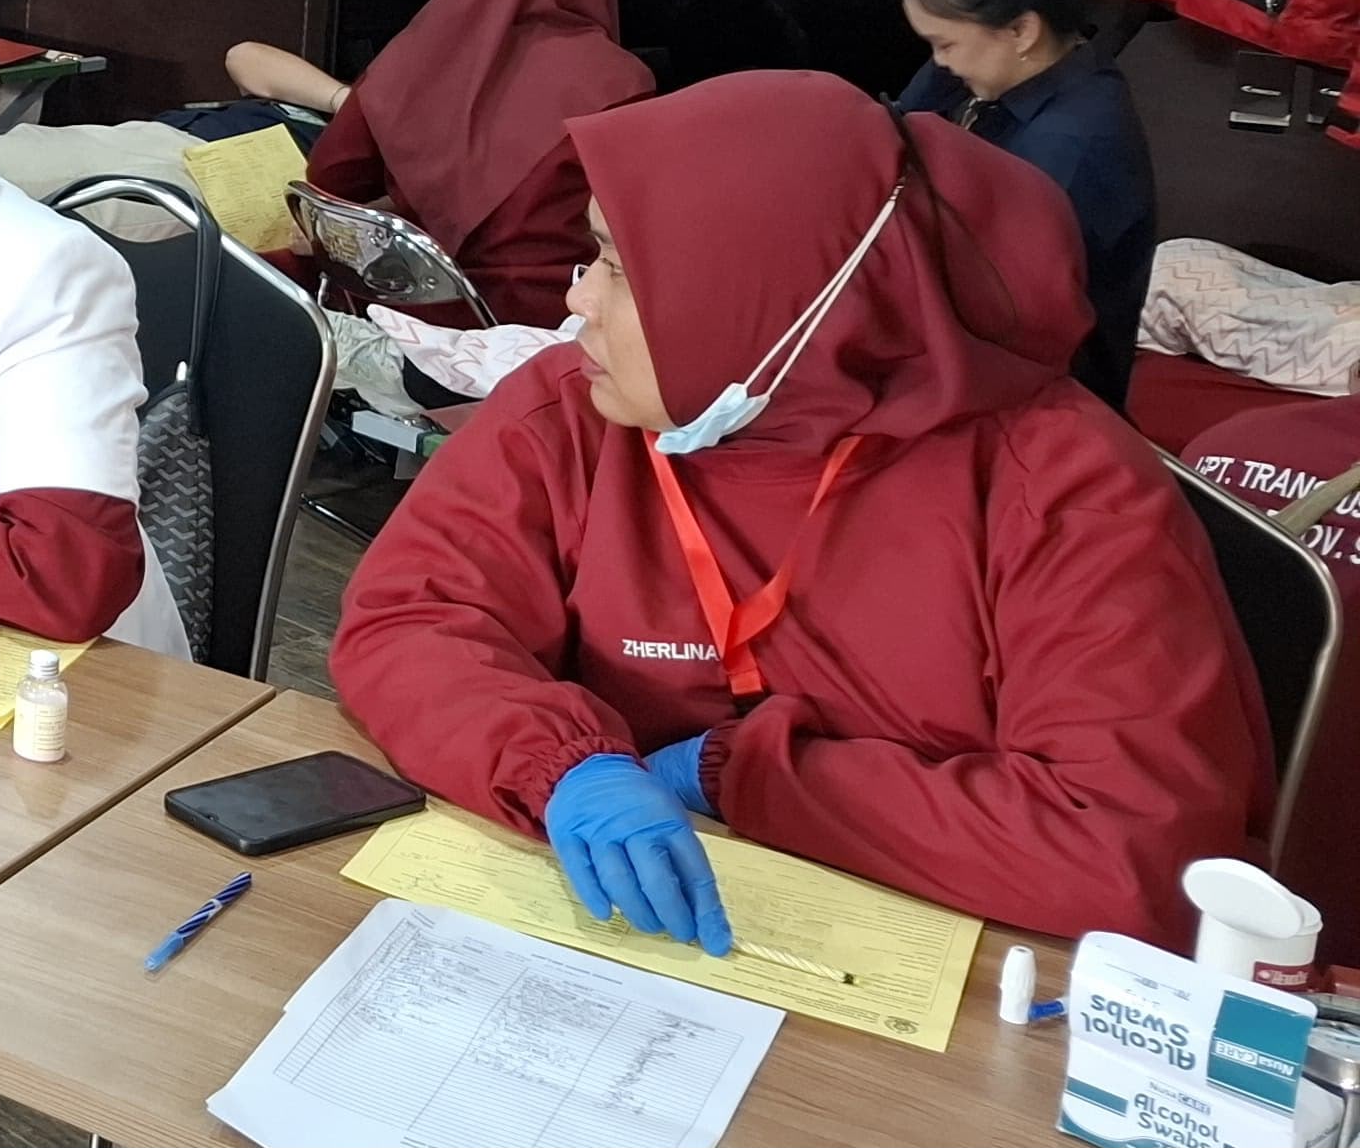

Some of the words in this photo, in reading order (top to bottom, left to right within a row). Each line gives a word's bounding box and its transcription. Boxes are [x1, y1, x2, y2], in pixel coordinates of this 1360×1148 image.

[621, 638, 721, 662] ZHERLINA
[1081, 1011, 1196, 1071] Alcohol
[1090, 994, 1190, 1048] Swabs
[1134, 1092, 1220, 1143] Alcohol
[1137, 1112, 1214, 1148] Swabs
